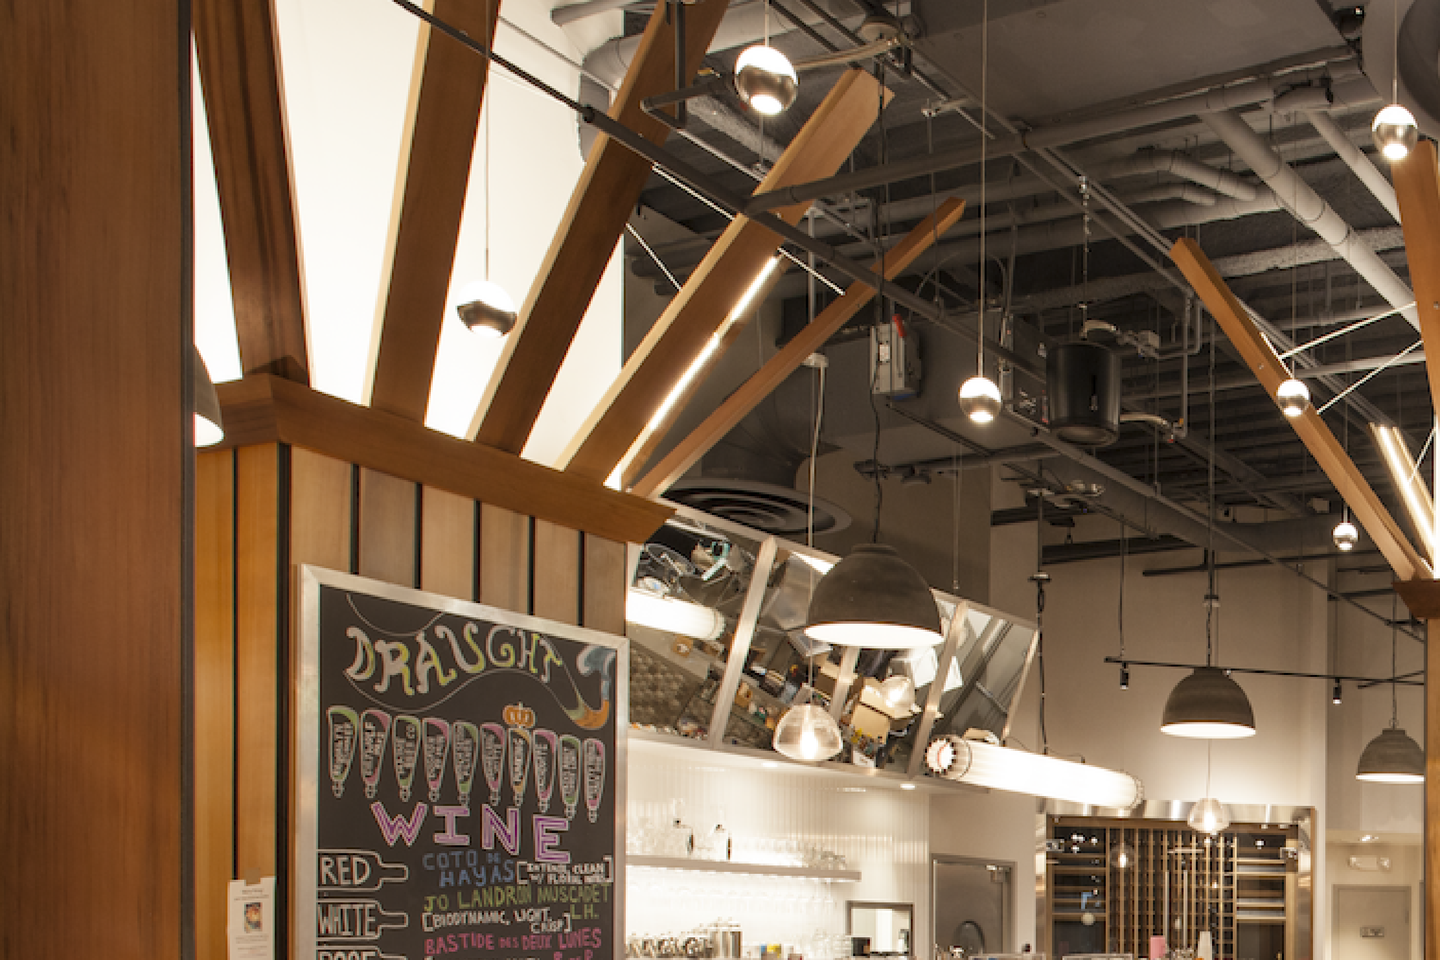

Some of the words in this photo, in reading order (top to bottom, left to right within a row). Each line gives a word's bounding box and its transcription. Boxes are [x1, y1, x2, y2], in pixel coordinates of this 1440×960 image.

[346, 621, 562, 695] DRAUGHT
[371, 801, 571, 863] WINE
[319, 856, 370, 884] RED
[423, 850, 477, 870] COTO
[439, 859, 514, 887] HAYAS
[424, 894, 448, 912] JO
[318, 905, 376, 937] WHITE
[424, 933, 494, 955] BASTIDE
[522, 935, 552, 950] DEUX
[558, 927, 601, 950] LUNES
